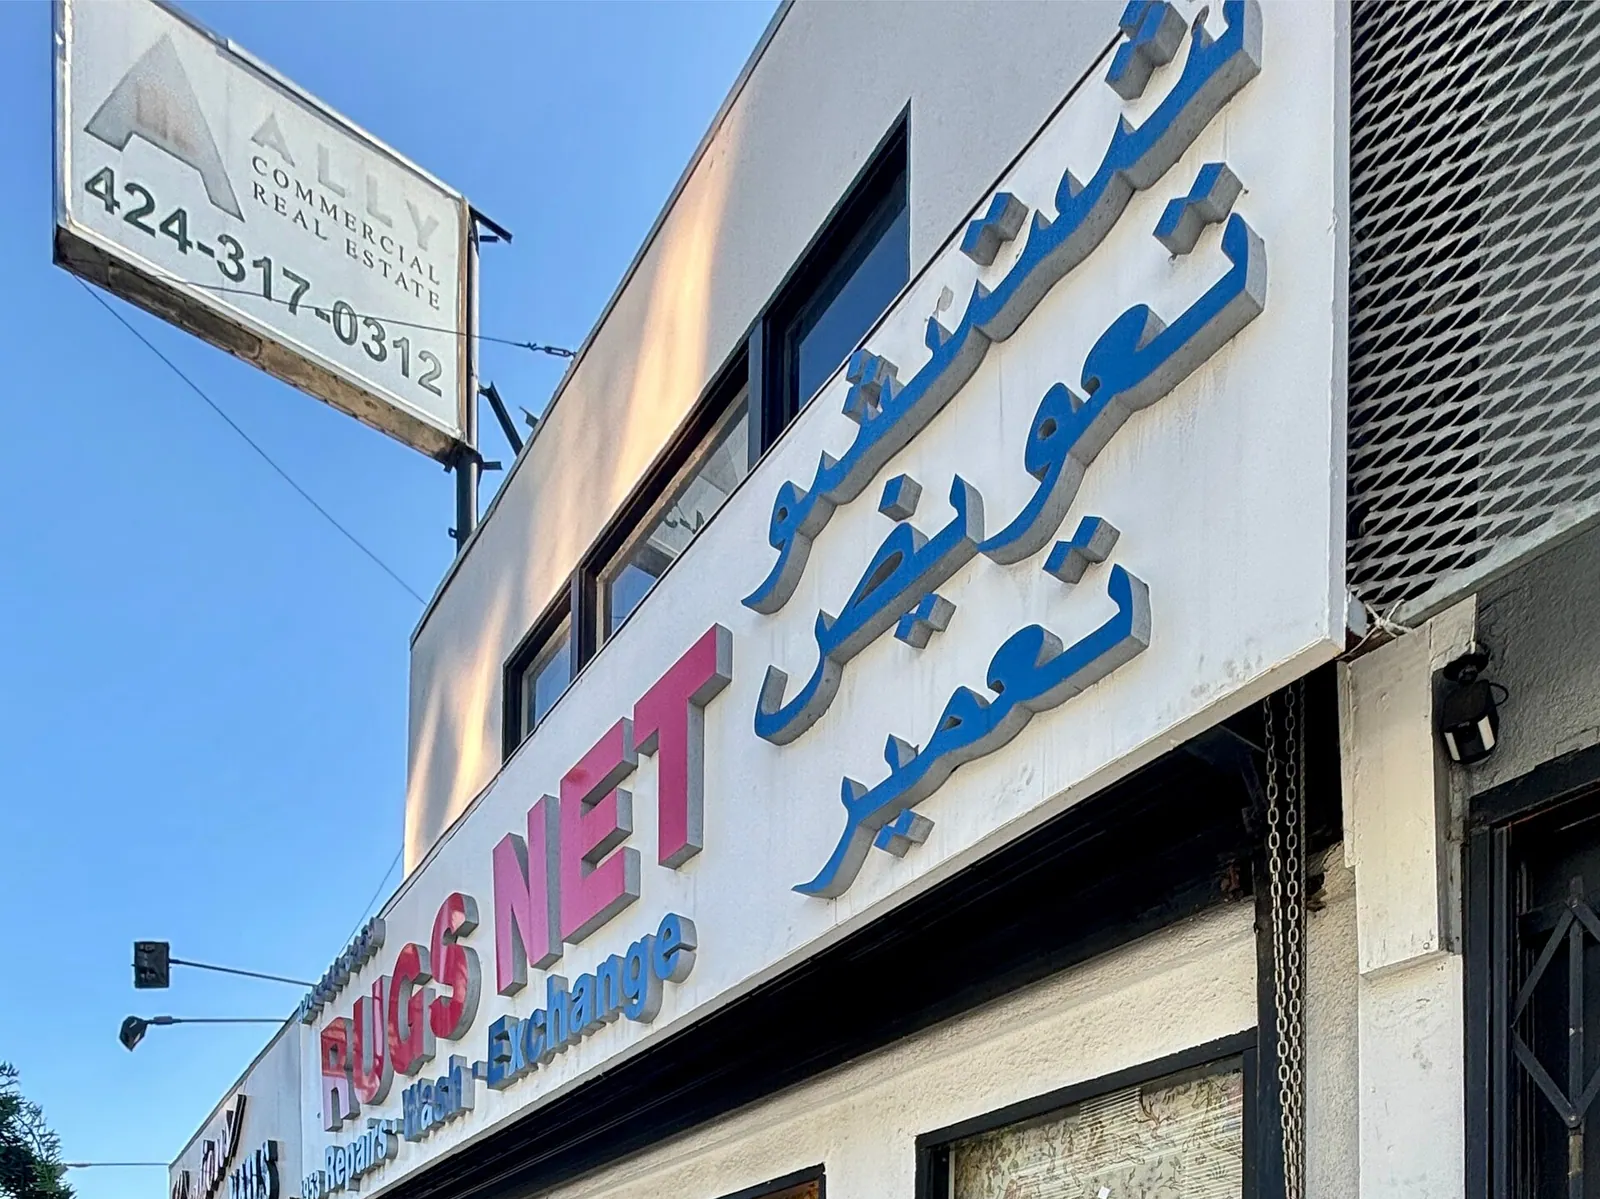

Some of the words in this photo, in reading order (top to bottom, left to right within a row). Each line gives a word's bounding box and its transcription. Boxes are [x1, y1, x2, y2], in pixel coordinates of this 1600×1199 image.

[251, 111, 440, 251] ALLY
[251, 155, 441, 286] COMMERCIAL
[252, 181, 328, 242] REAL
[345, 238, 441, 311] ESTATE
[84, 166, 443, 398] 424-317-0312
[320, 892, 481, 1131] RUGS
[493, 622, 732, 996] NET
[325, 1115, 398, 1191] Repairs
[402, 1055, 474, 1143] Wash
[487, 912, 697, 1090] Exchange
